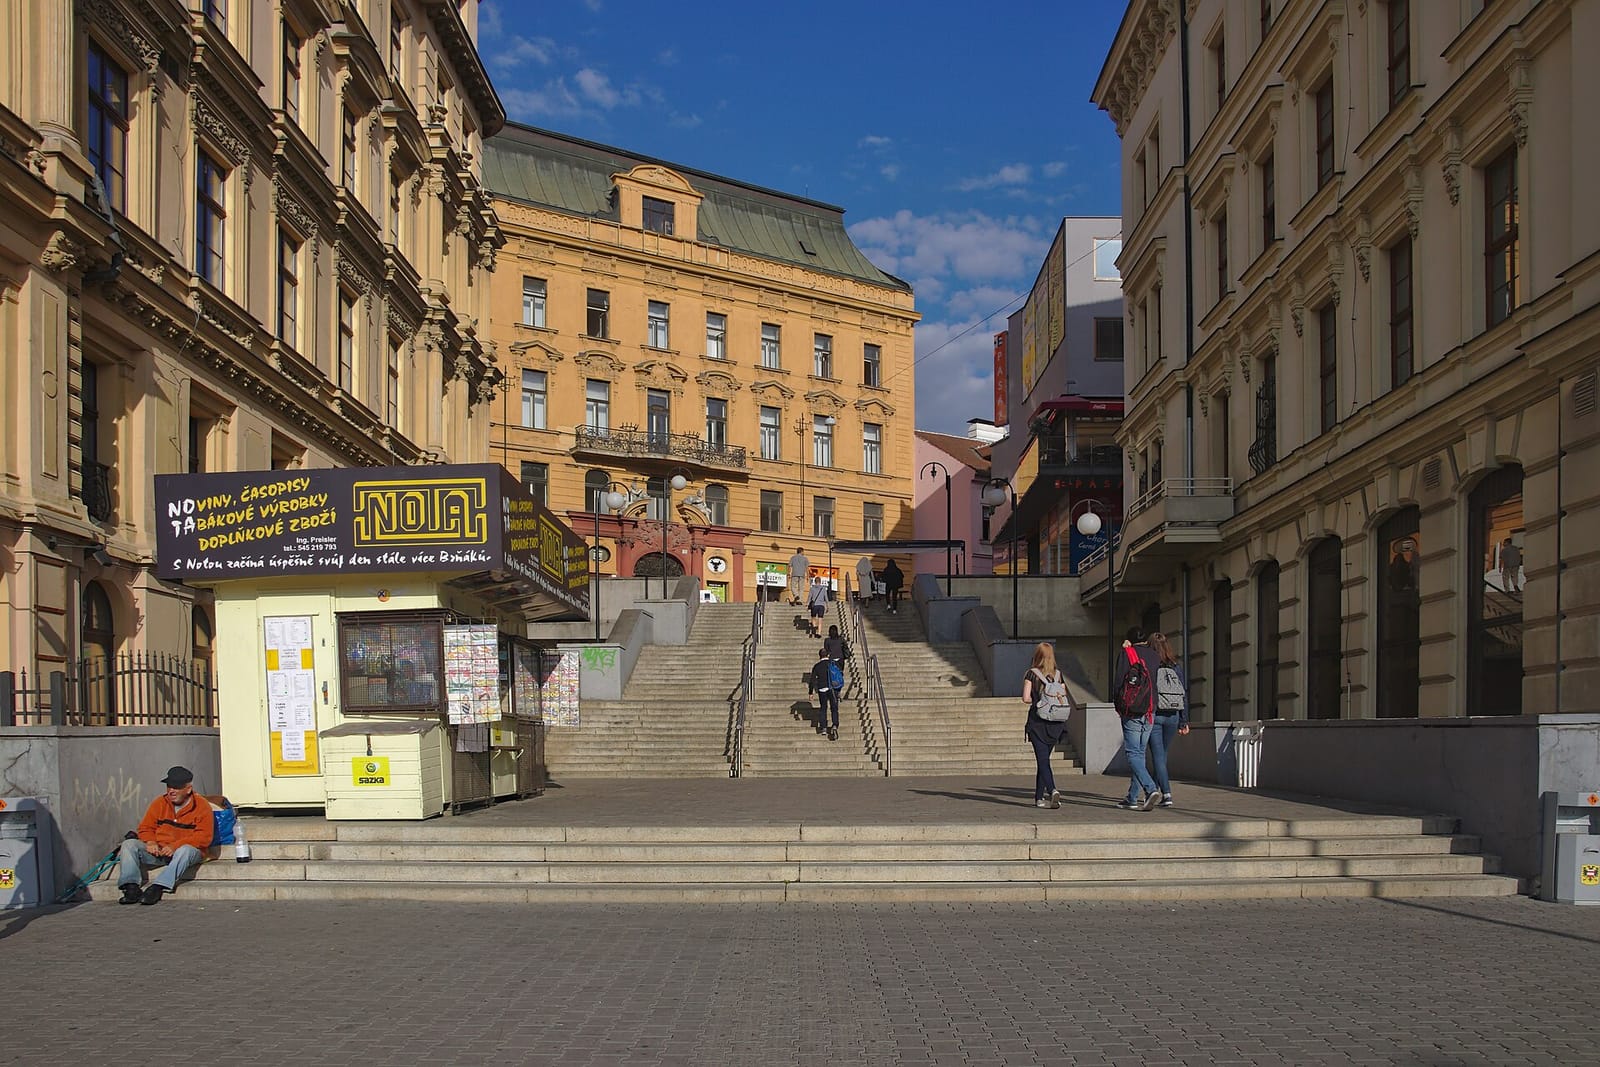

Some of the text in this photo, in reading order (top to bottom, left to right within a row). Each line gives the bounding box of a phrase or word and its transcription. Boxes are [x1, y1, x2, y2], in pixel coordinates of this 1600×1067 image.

[241, 477, 311, 502] ČASOPISY
[259, 492, 328, 519] VÝROBKY
[198, 507, 337, 551] DOPLŇKOVÉ ZBOŽÍ
[173, 558, 181, 570] S
[186, 557, 223, 571] Notou
[226, 555, 264, 569] začíná
[269, 553, 314, 571] úspěšně
[348, 552, 371, 566] den
[376, 551, 406, 565] stále
[411, 551, 435, 564] více
